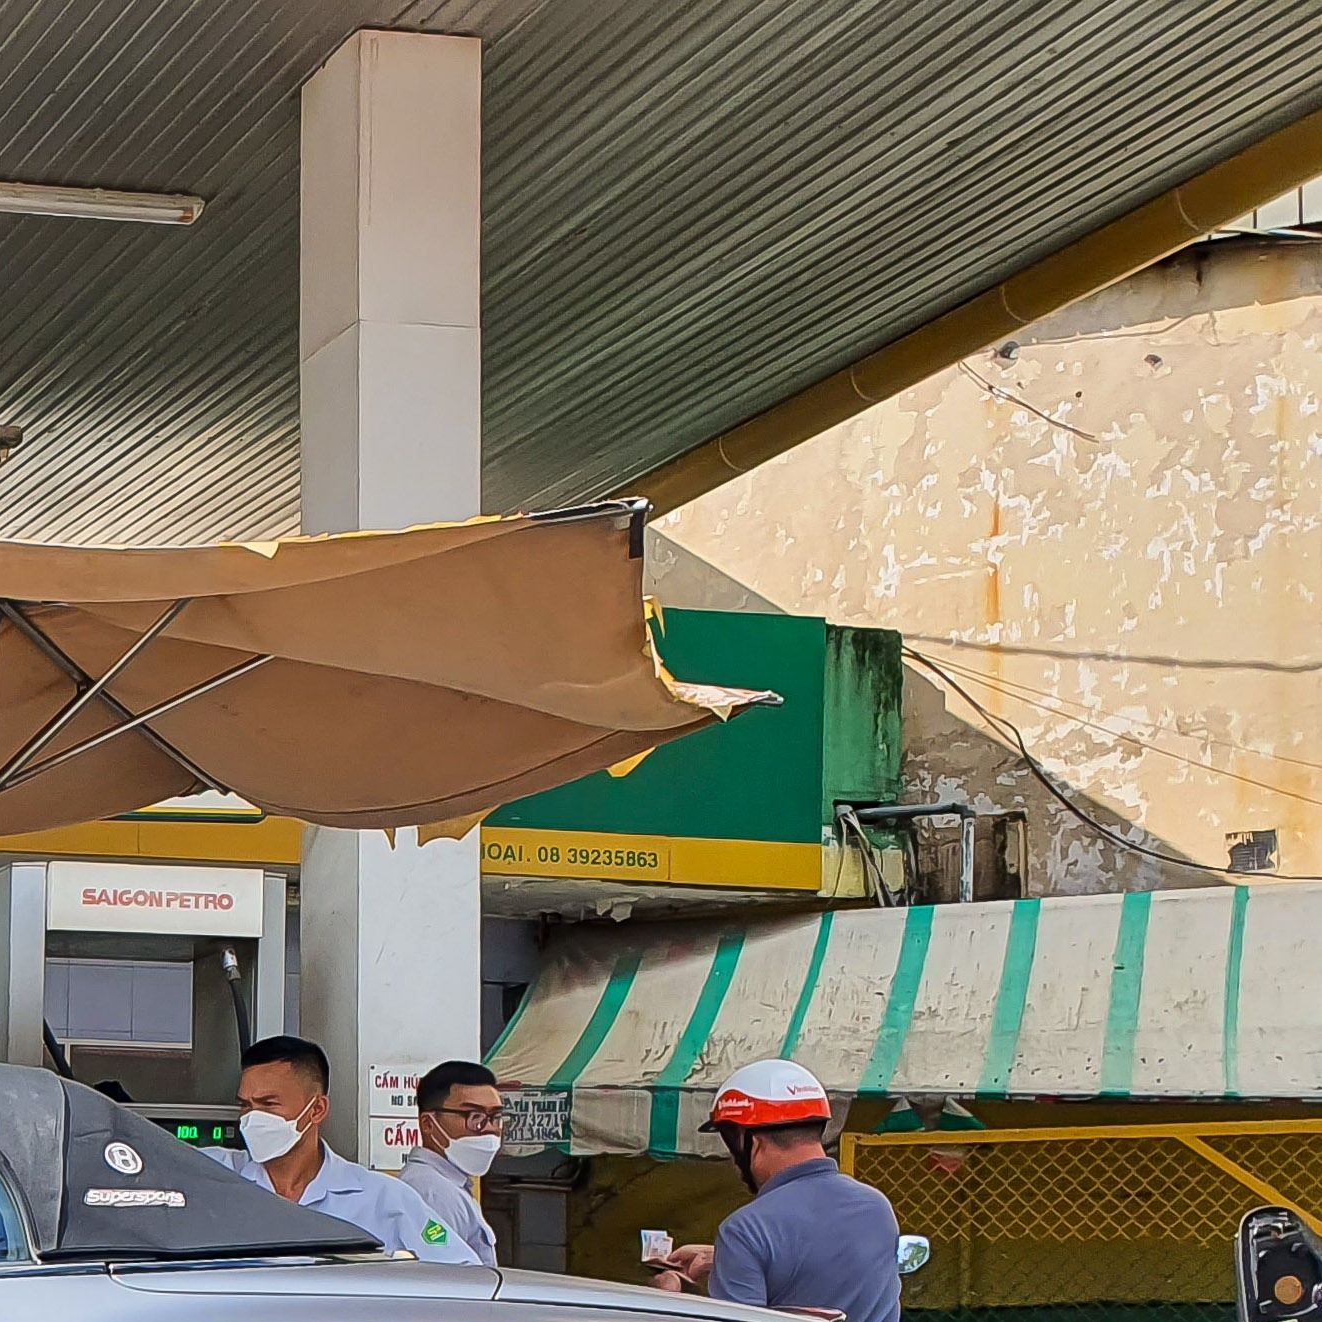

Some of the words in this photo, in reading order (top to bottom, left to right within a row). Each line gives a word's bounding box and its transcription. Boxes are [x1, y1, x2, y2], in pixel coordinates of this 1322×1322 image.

[537, 846, 560, 863] 08
[567, 848, 659, 868] 39235863
[375, 1071, 399, 1089] CẤM
[403, 1070, 419, 1089] HÚ
[384, 1121, 419, 1146] CẤM
[86, 1190, 185, 1206] Supersports
